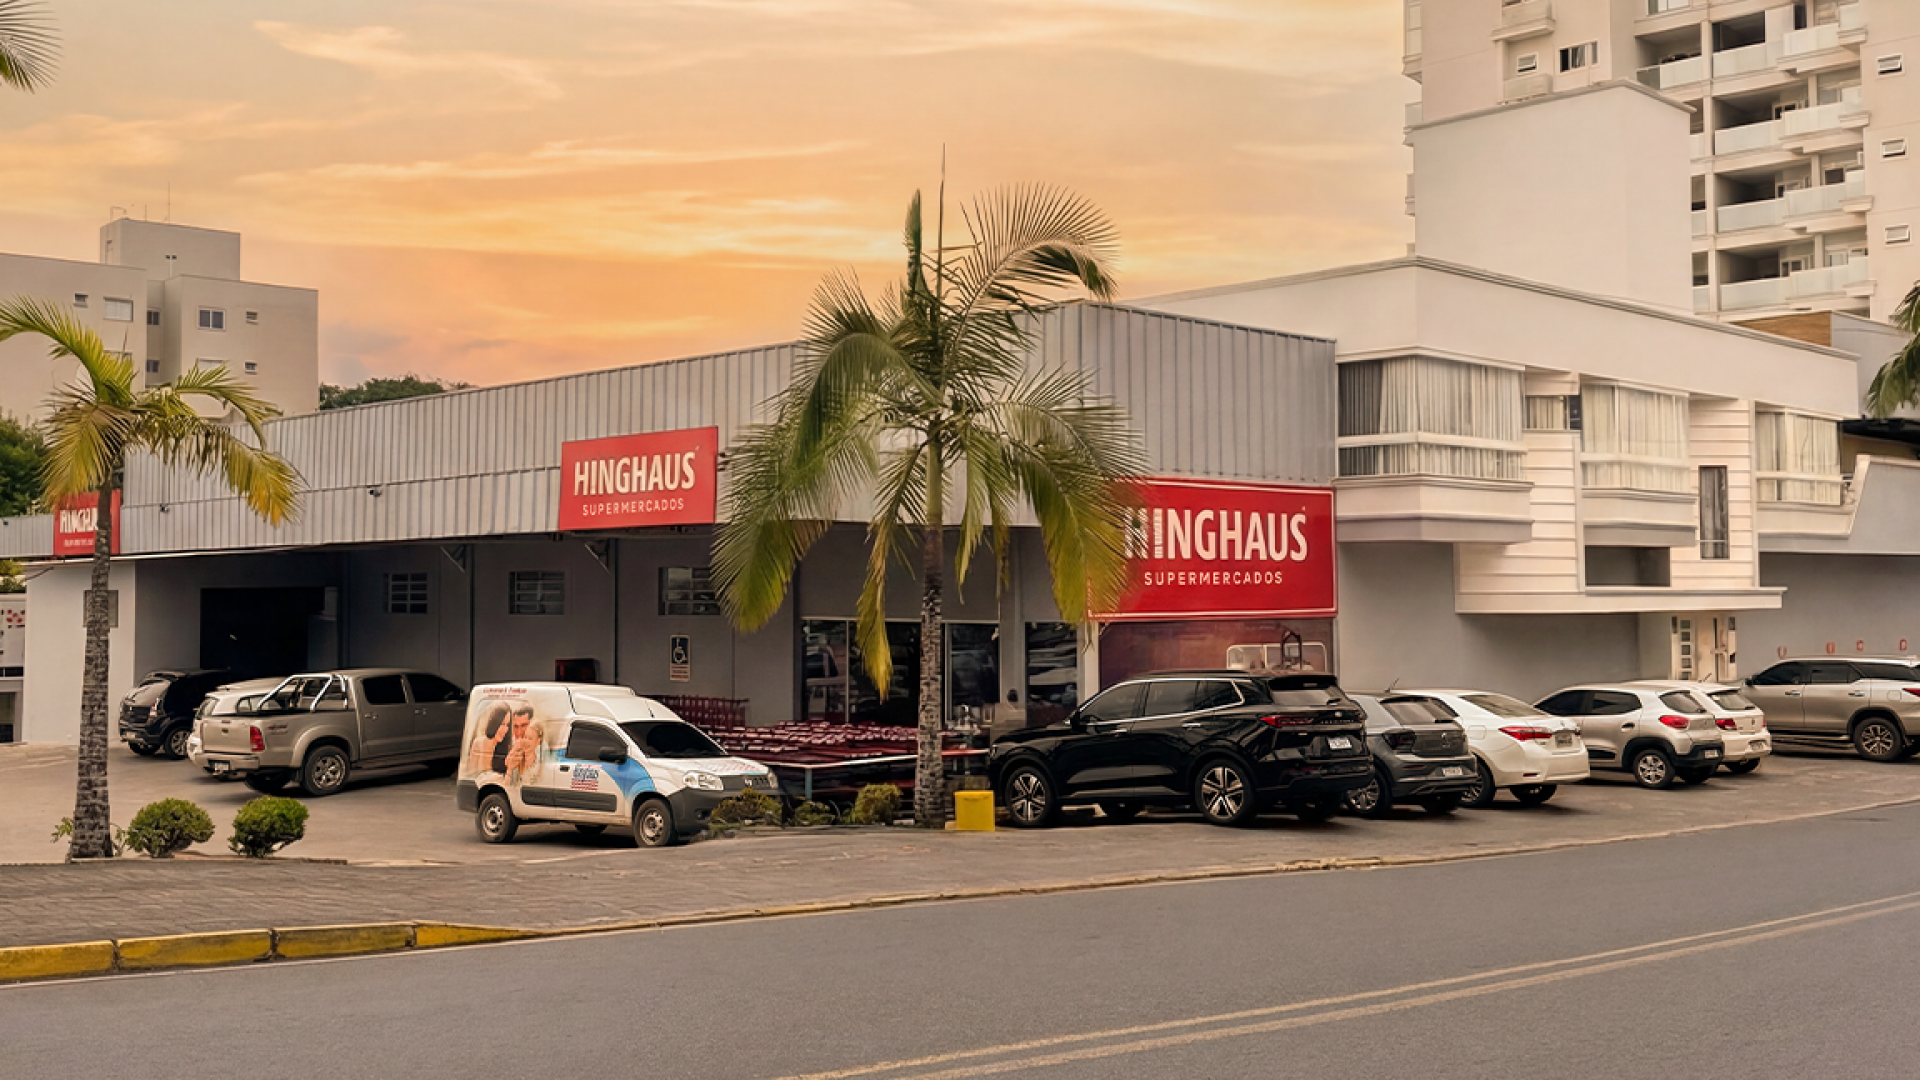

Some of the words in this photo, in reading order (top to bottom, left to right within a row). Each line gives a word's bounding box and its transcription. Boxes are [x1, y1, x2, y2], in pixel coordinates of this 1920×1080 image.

[574, 451, 696, 496] HINGHAUS
[582, 498, 684, 516] SUPERMERCADOS
[1144, 571, 1283, 586] SUPERMERCADOS
